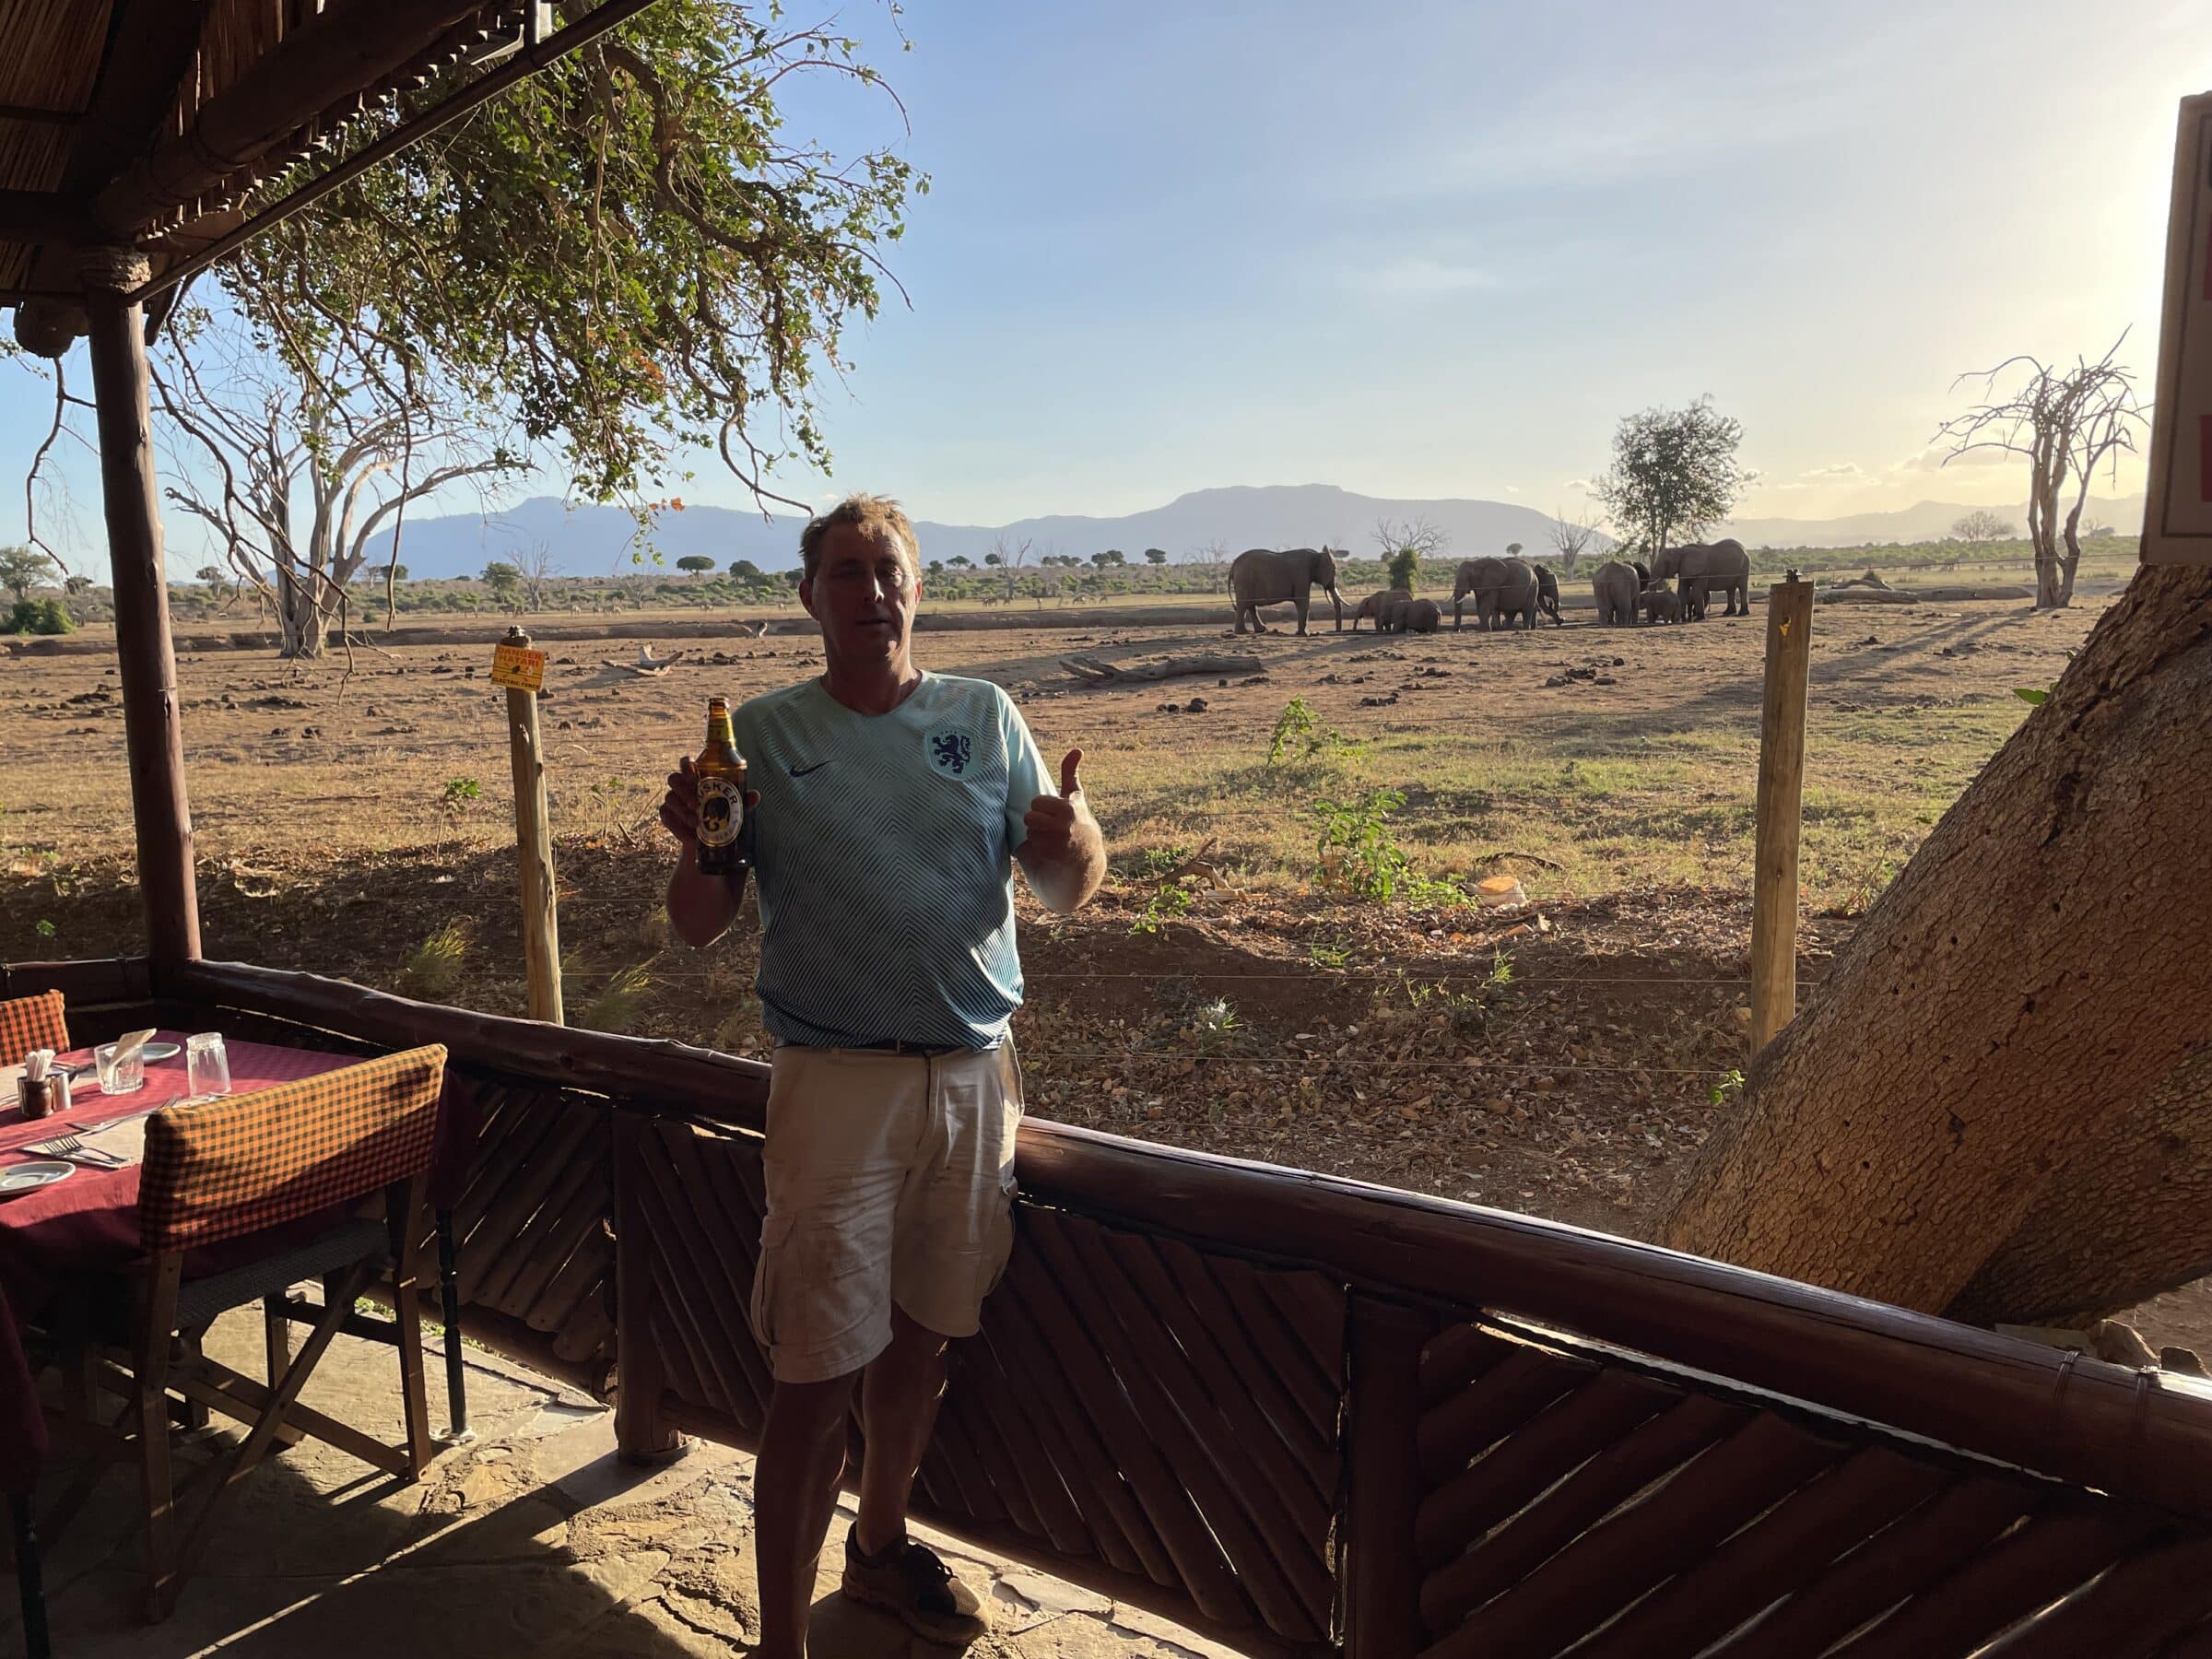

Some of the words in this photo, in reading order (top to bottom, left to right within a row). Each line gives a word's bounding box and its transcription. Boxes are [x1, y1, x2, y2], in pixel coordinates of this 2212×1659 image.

[498, 647, 542, 661] DANGER
[500, 654, 539, 667] HATARI
[492, 677, 521, 687] ELECTRIC
[698, 782, 738, 805] USKER
